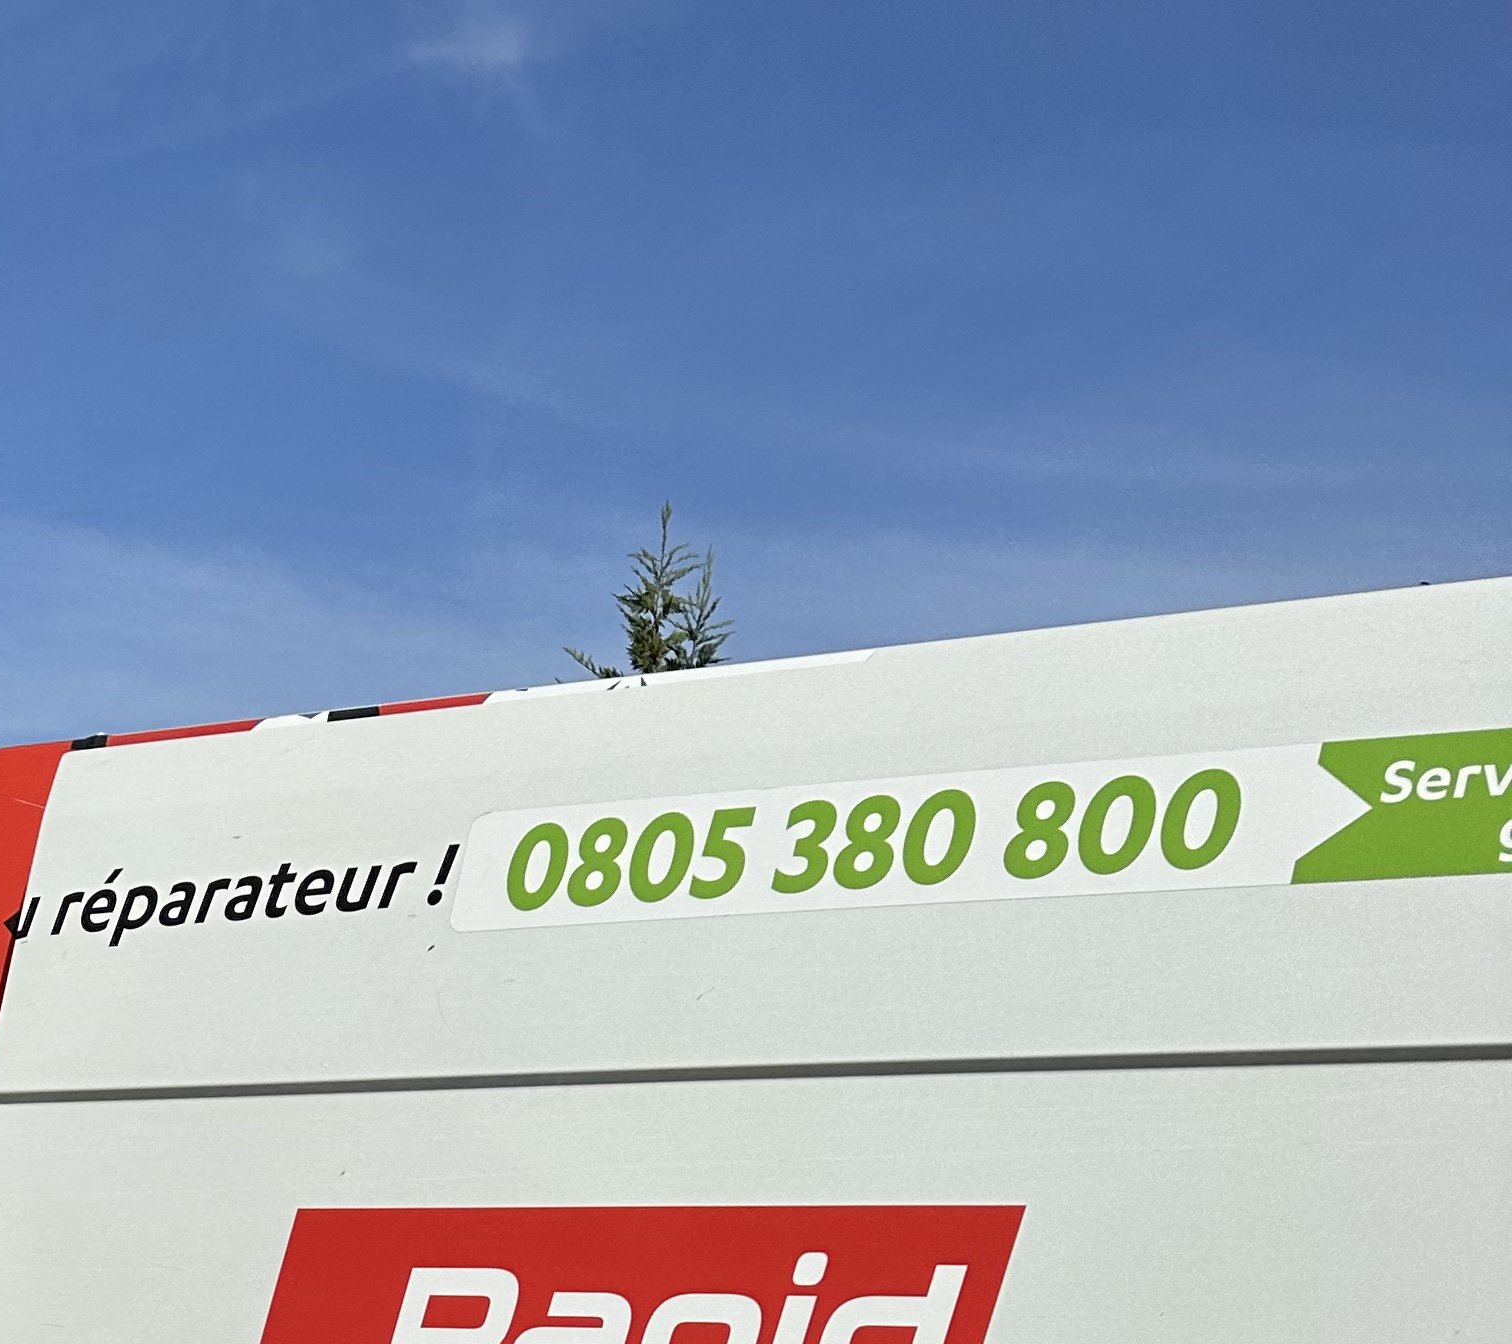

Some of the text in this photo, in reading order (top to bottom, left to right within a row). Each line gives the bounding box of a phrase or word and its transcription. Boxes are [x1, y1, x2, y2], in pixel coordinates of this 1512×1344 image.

[50, 861, 417, 947] réparateur
[426, 844, 460, 905] !
[506, 806, 756, 911] 0805
[771, 788, 977, 894] 380
[1003, 768, 1242, 880] 800
